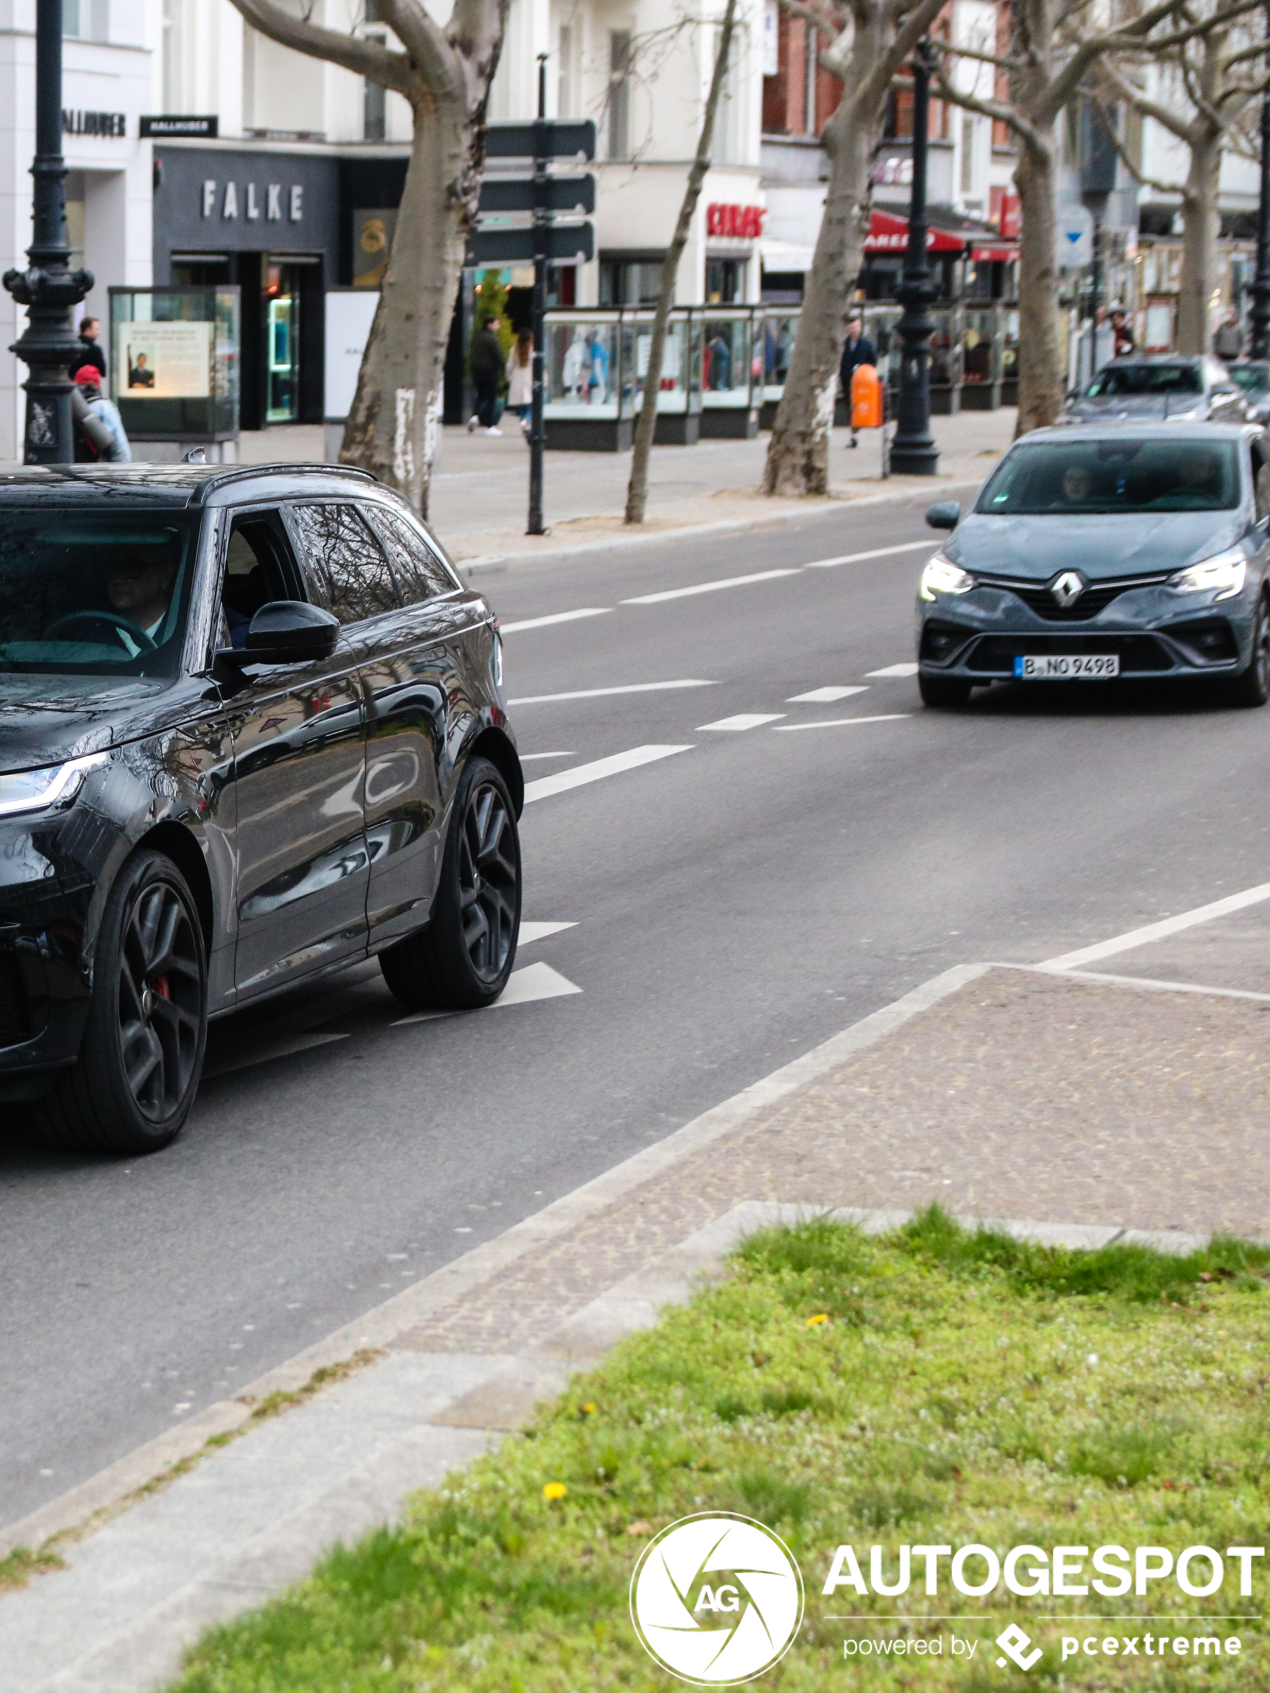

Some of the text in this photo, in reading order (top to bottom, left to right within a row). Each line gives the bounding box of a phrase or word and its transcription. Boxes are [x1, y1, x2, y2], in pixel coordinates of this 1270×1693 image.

[150, 120, 209, 132] HALLHUBER
[202, 179, 304, 221] FALKE
[1025, 658, 1116, 675] B NO 9498
